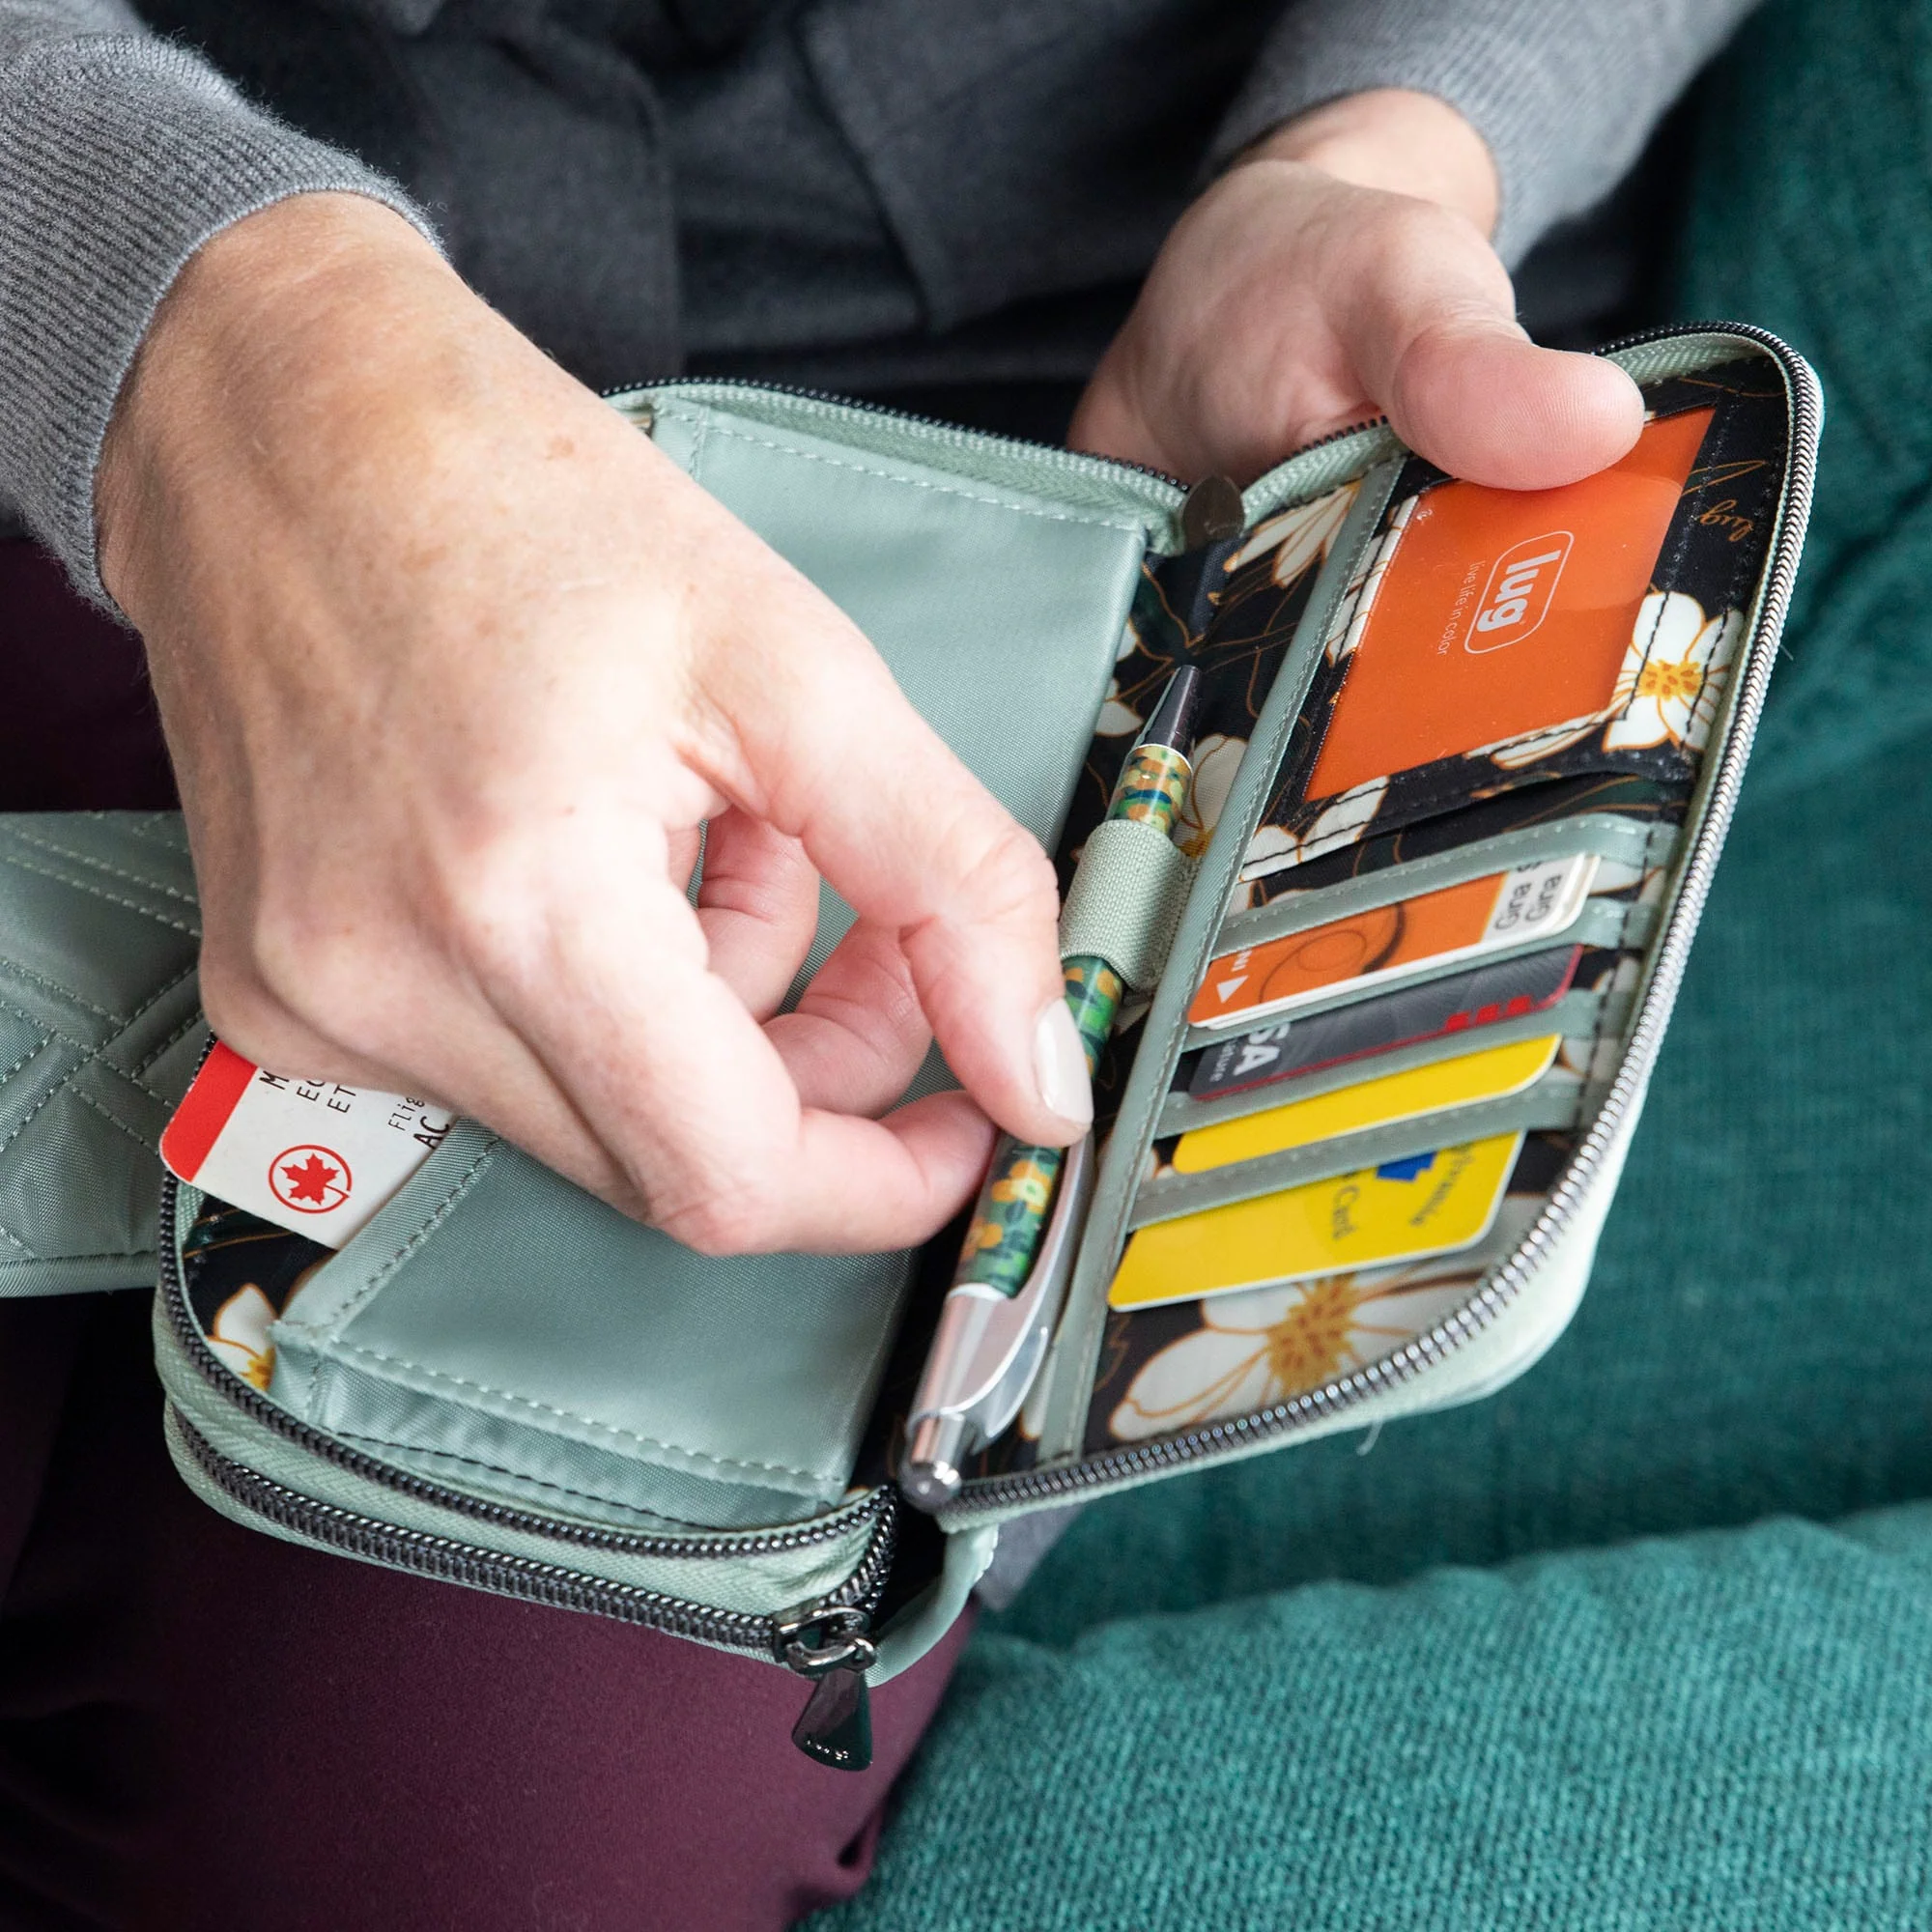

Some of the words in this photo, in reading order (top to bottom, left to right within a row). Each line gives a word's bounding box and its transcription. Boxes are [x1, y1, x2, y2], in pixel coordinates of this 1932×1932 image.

[1463, 559, 1487, 583] live
[1455, 584, 1476, 606] life
[1476, 549, 1562, 633] lug
[1452, 606, 1469, 618] in
[1436, 621, 1458, 655] color
[1493, 883, 1532, 930] Gina
[1524, 875, 1562, 922] Gina
[413, 1115, 449, 1150] AC
